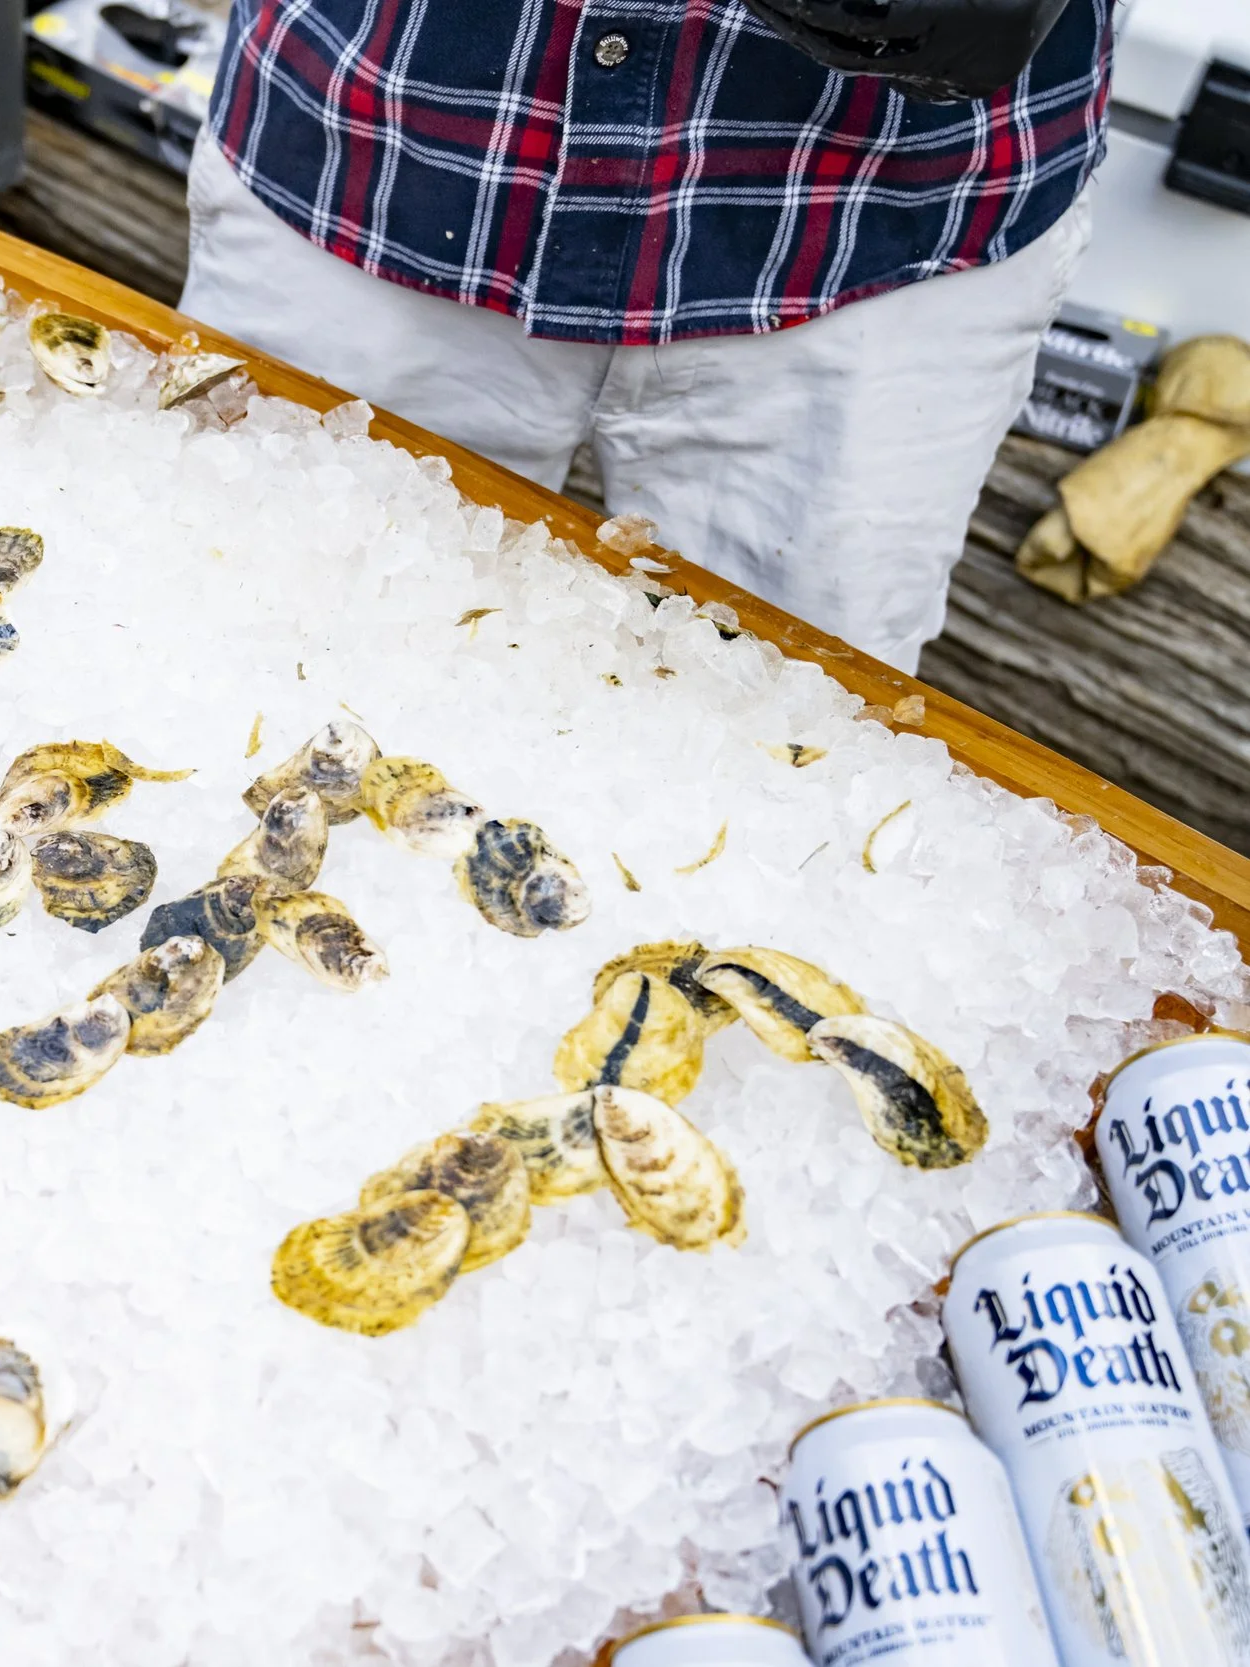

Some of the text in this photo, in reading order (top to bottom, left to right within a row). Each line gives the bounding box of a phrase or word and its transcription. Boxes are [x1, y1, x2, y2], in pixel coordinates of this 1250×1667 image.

[1109, 1078, 1250, 1180] Liqui
[1151, 1209, 1238, 1256] MOUNTAIN
[973, 1264, 1157, 1355] Liquid
[1006, 1331, 1182, 1413] Death
[1022, 1401, 1124, 1439] MOUNTAIN
[787, 1458, 956, 1559] Liquid
[808, 1530, 979, 1637] Death
